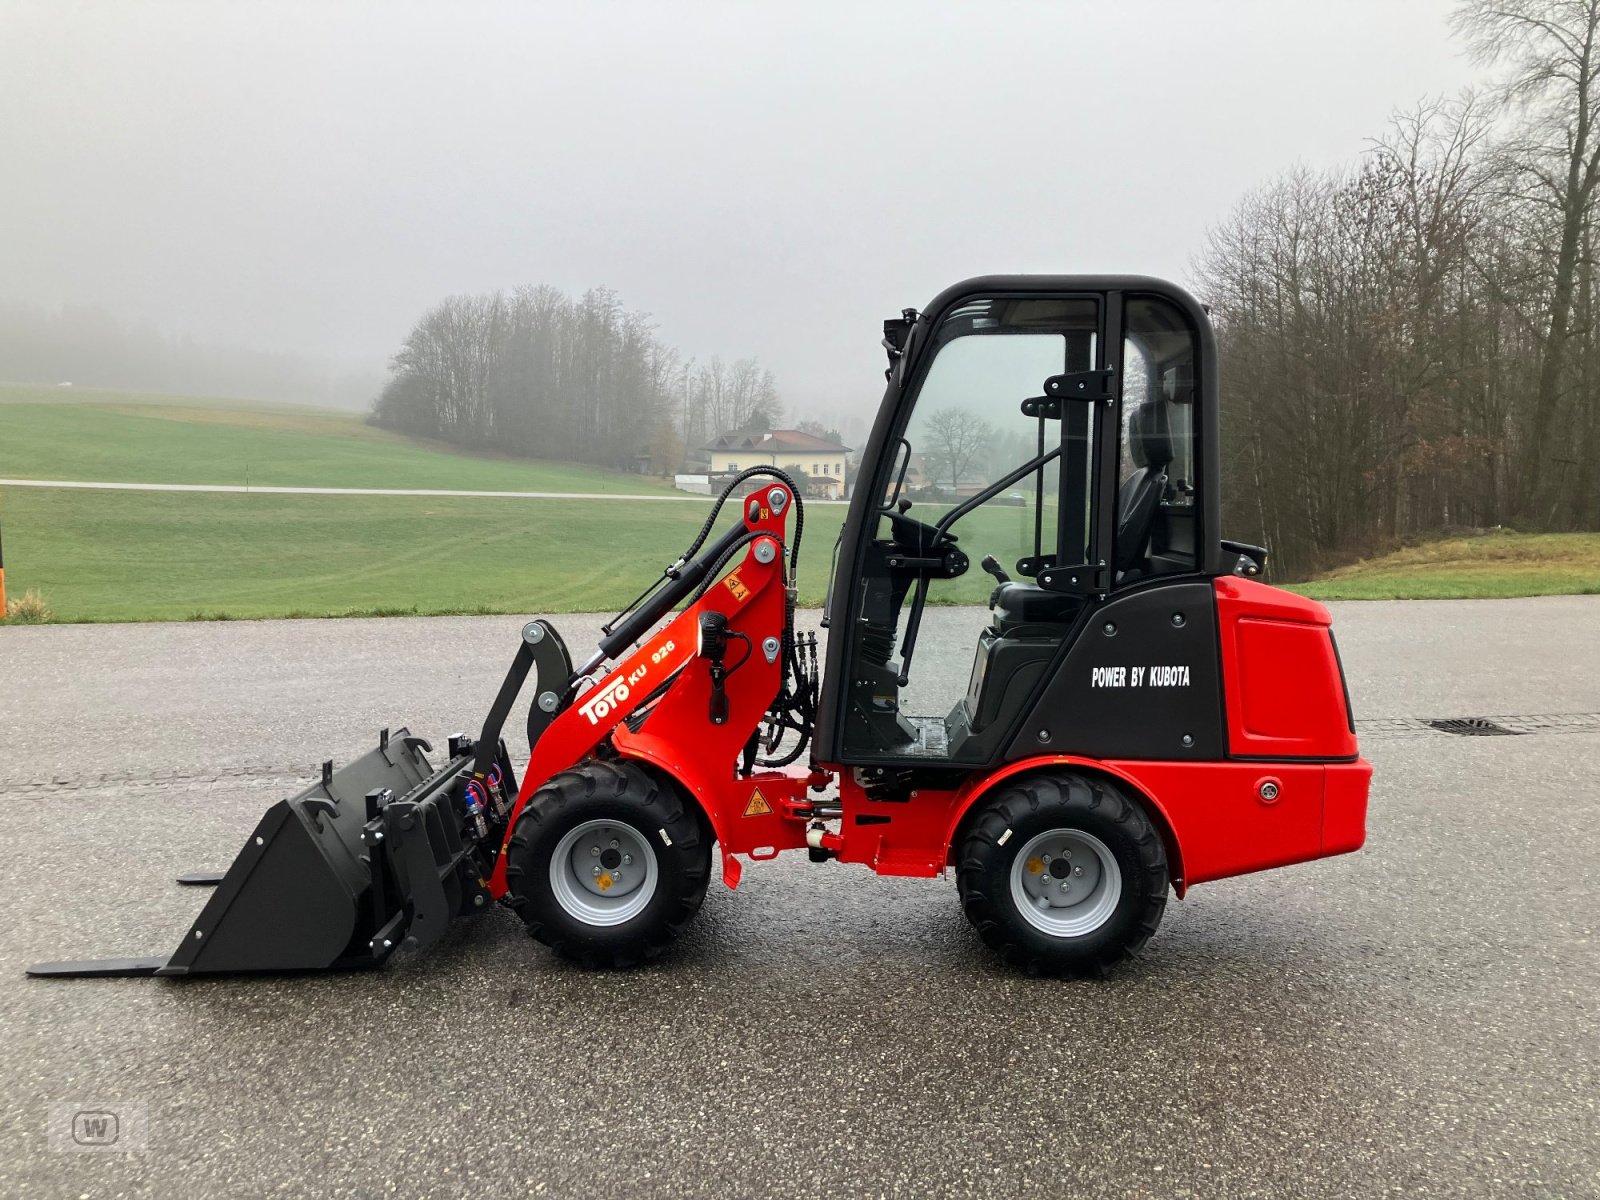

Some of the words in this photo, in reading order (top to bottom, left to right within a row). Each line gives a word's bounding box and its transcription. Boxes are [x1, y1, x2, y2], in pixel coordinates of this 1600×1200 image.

[578, 675, 630, 725] TOYO
[628, 664, 648, 686] KU
[651, 640, 676, 664] 926
[1091, 666, 1127, 688] POWER
[1130, 666, 1146, 688] BY
[1149, 665, 1191, 687] KUBOTA
